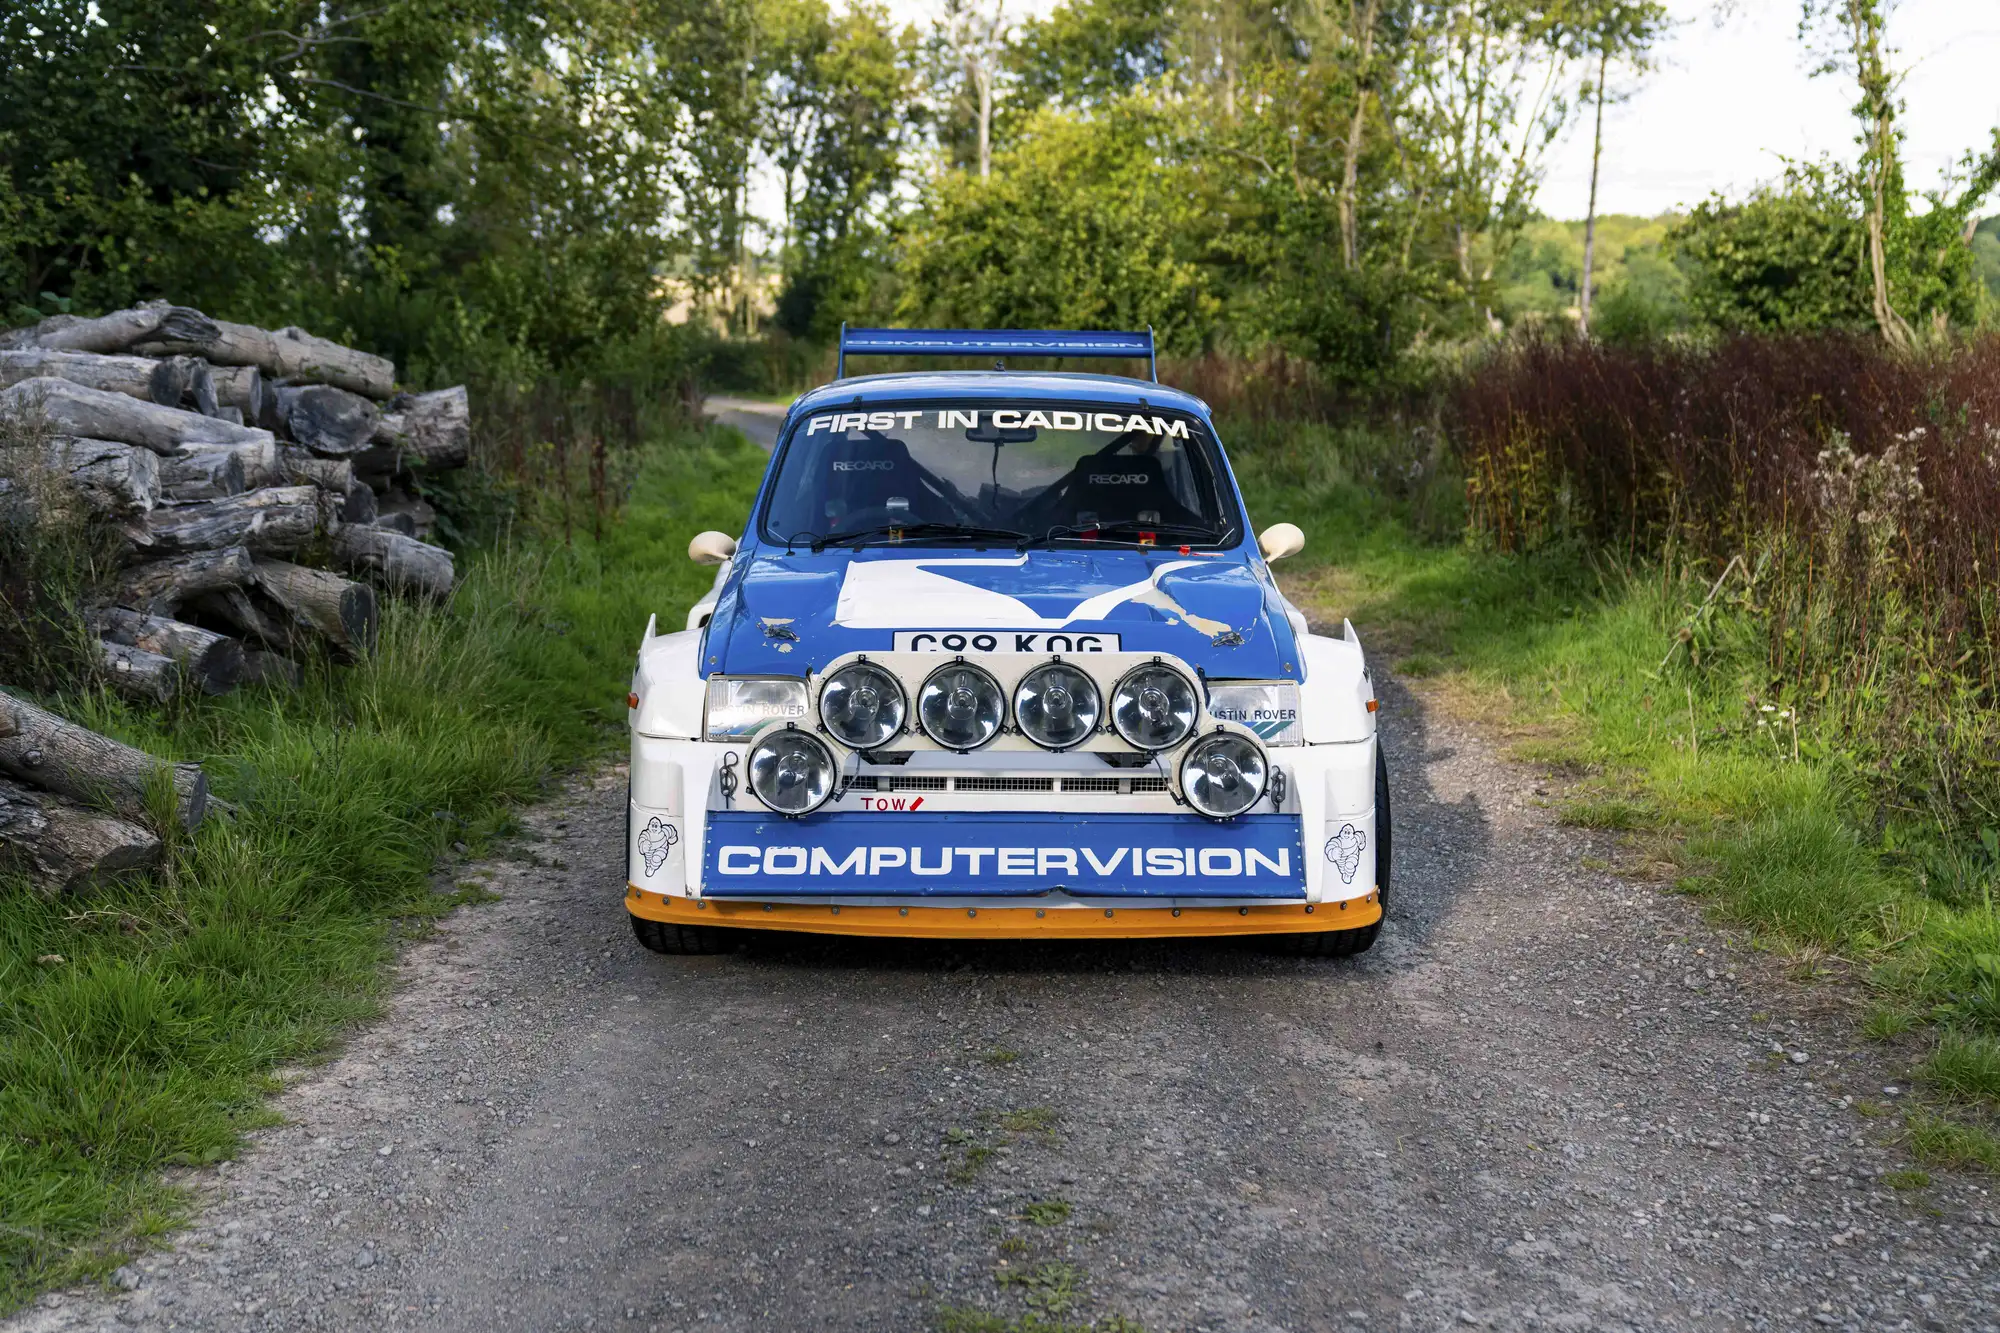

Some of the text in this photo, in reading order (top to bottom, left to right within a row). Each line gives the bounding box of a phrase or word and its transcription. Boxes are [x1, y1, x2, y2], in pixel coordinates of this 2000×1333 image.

[806, 410, 1190, 439] FIRST IN CAD/CAM
[833, 460, 895, 471] RECARO
[1089, 474, 1149, 484] RECARO
[763, 704, 805, 715] ROVER
[1209, 709, 1296, 720] USTIN ROVER
[860, 797, 906, 811] TOW
[718, 845, 1291, 876] COMPUTERVISION
